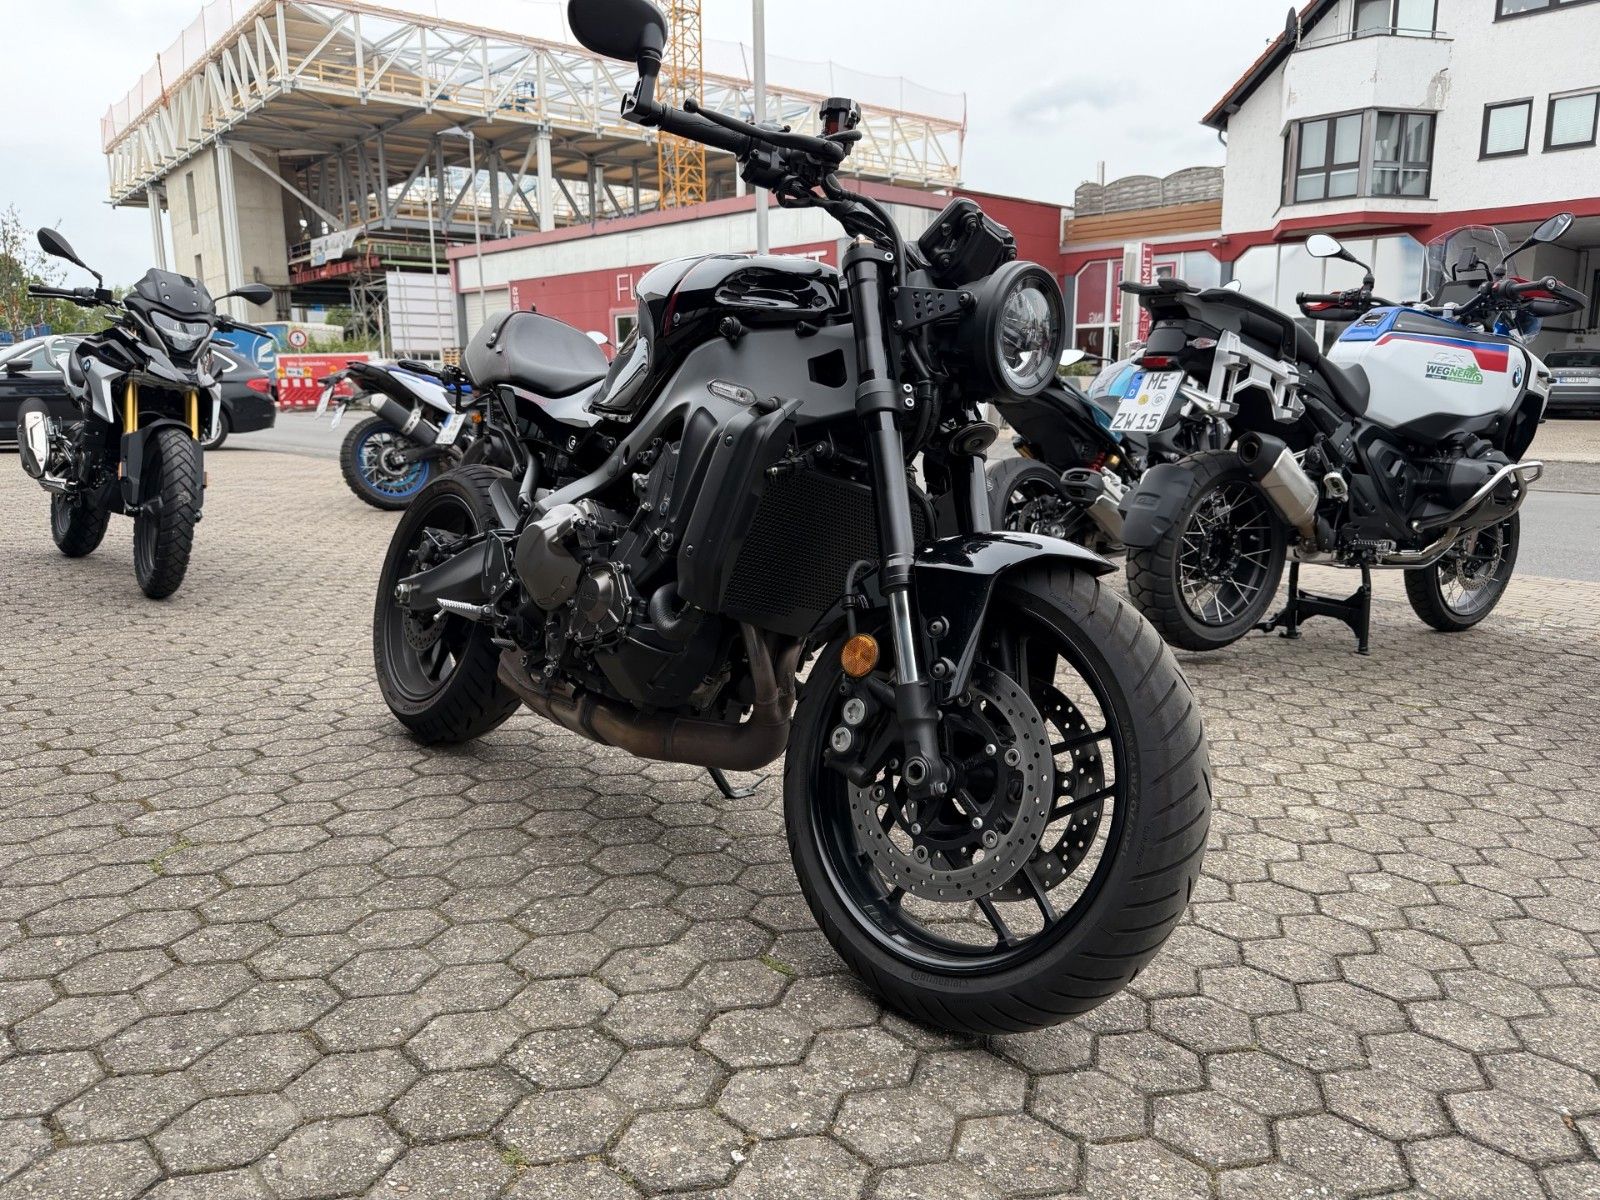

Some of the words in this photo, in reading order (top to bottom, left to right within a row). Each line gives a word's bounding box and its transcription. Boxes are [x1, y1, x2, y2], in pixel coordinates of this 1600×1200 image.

[1426, 364, 1470, 378] WEGNER
[1145, 373, 1170, 390] ME
[1112, 413, 1136, 429] ZW
[1136, 413, 1161, 430] 15
